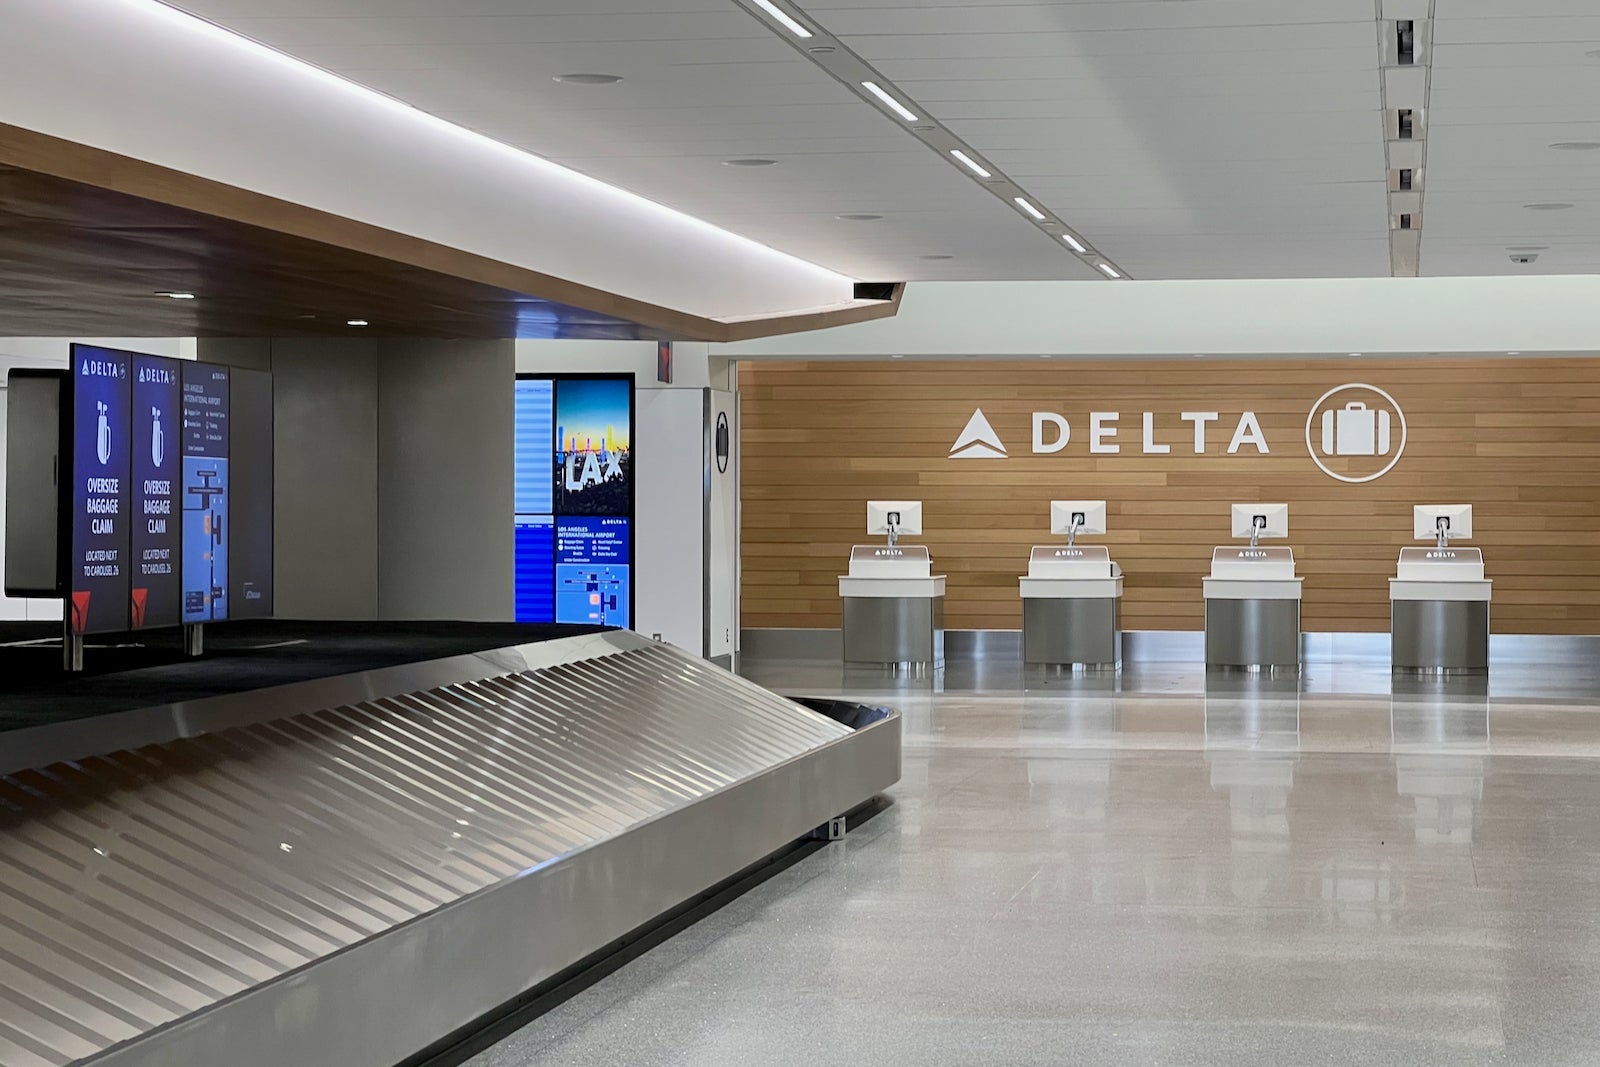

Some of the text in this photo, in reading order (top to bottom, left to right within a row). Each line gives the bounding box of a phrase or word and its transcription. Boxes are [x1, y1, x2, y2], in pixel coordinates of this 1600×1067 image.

[90, 360, 118, 377] DELTA
[146, 367, 170, 384] DELTA
[1032, 411, 1270, 454] DELTA
[565, 450, 625, 492] LAX
[87, 477, 119, 494] OVERSIZE
[143, 479, 171, 495] OVERSIZE
[86, 498, 119, 514] BAGGAGE
[143, 499, 171, 515] BAGGAGE
[91, 519, 114, 534] CLAIM
[147, 519, 167, 534] CLAIM
[85, 549, 118, 562] LOCATED NEXT
[143, 548, 170, 560] LOCATED NEXT
[83, 565, 91, 577] TO
[91, 565, 112, 576] CAROUSEL
